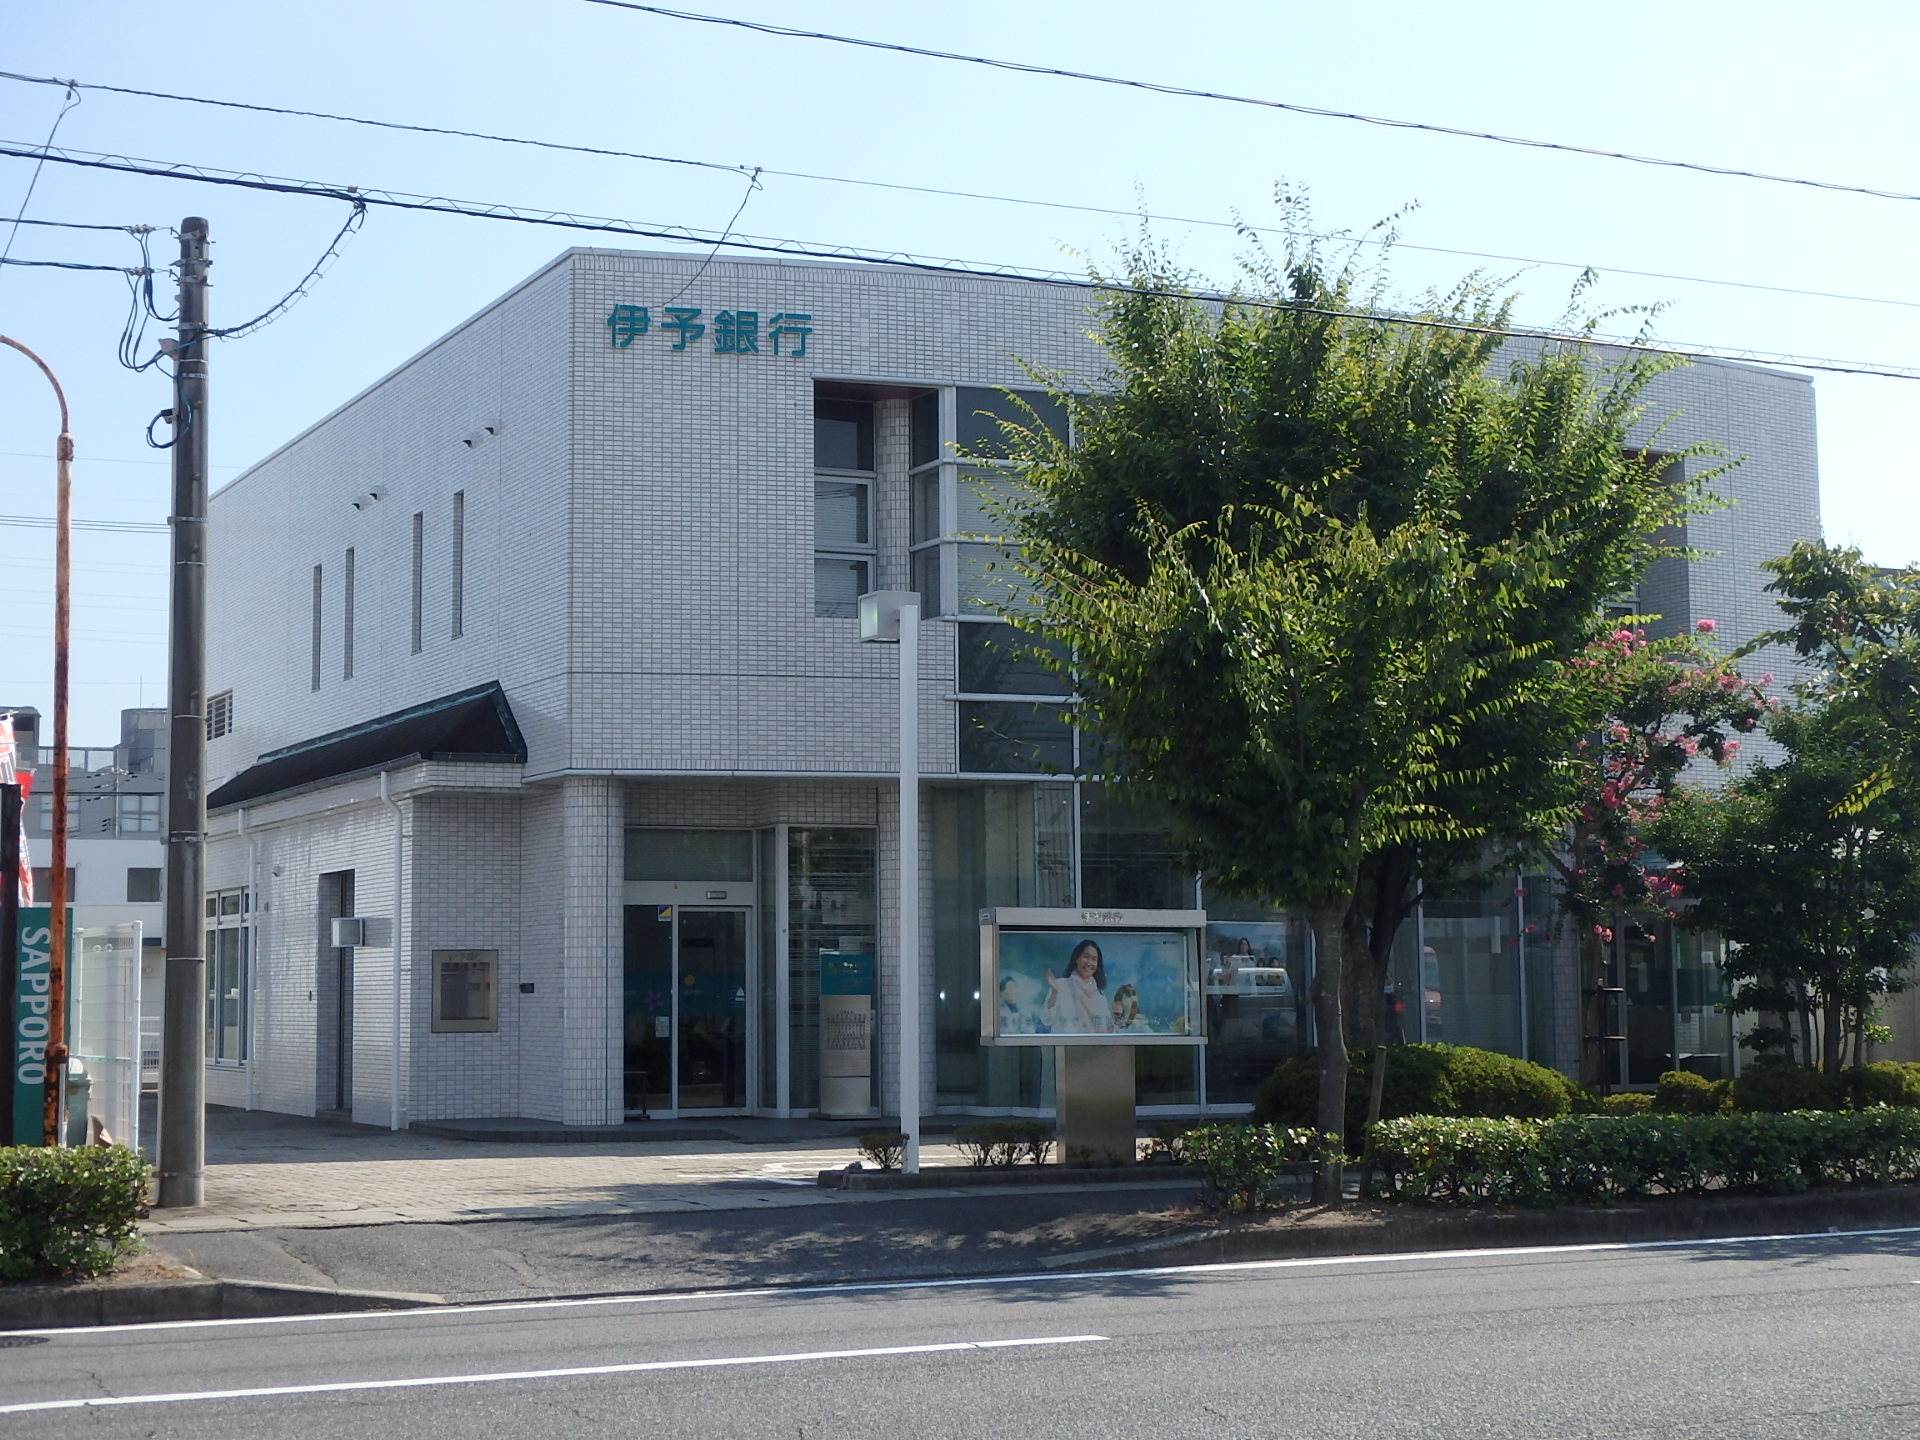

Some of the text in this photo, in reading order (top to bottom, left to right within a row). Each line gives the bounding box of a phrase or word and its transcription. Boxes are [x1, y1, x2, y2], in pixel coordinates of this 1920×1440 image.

[607, 304, 813, 357] 伊予銀行
[18, 927, 51, 1085] SAPPORO
